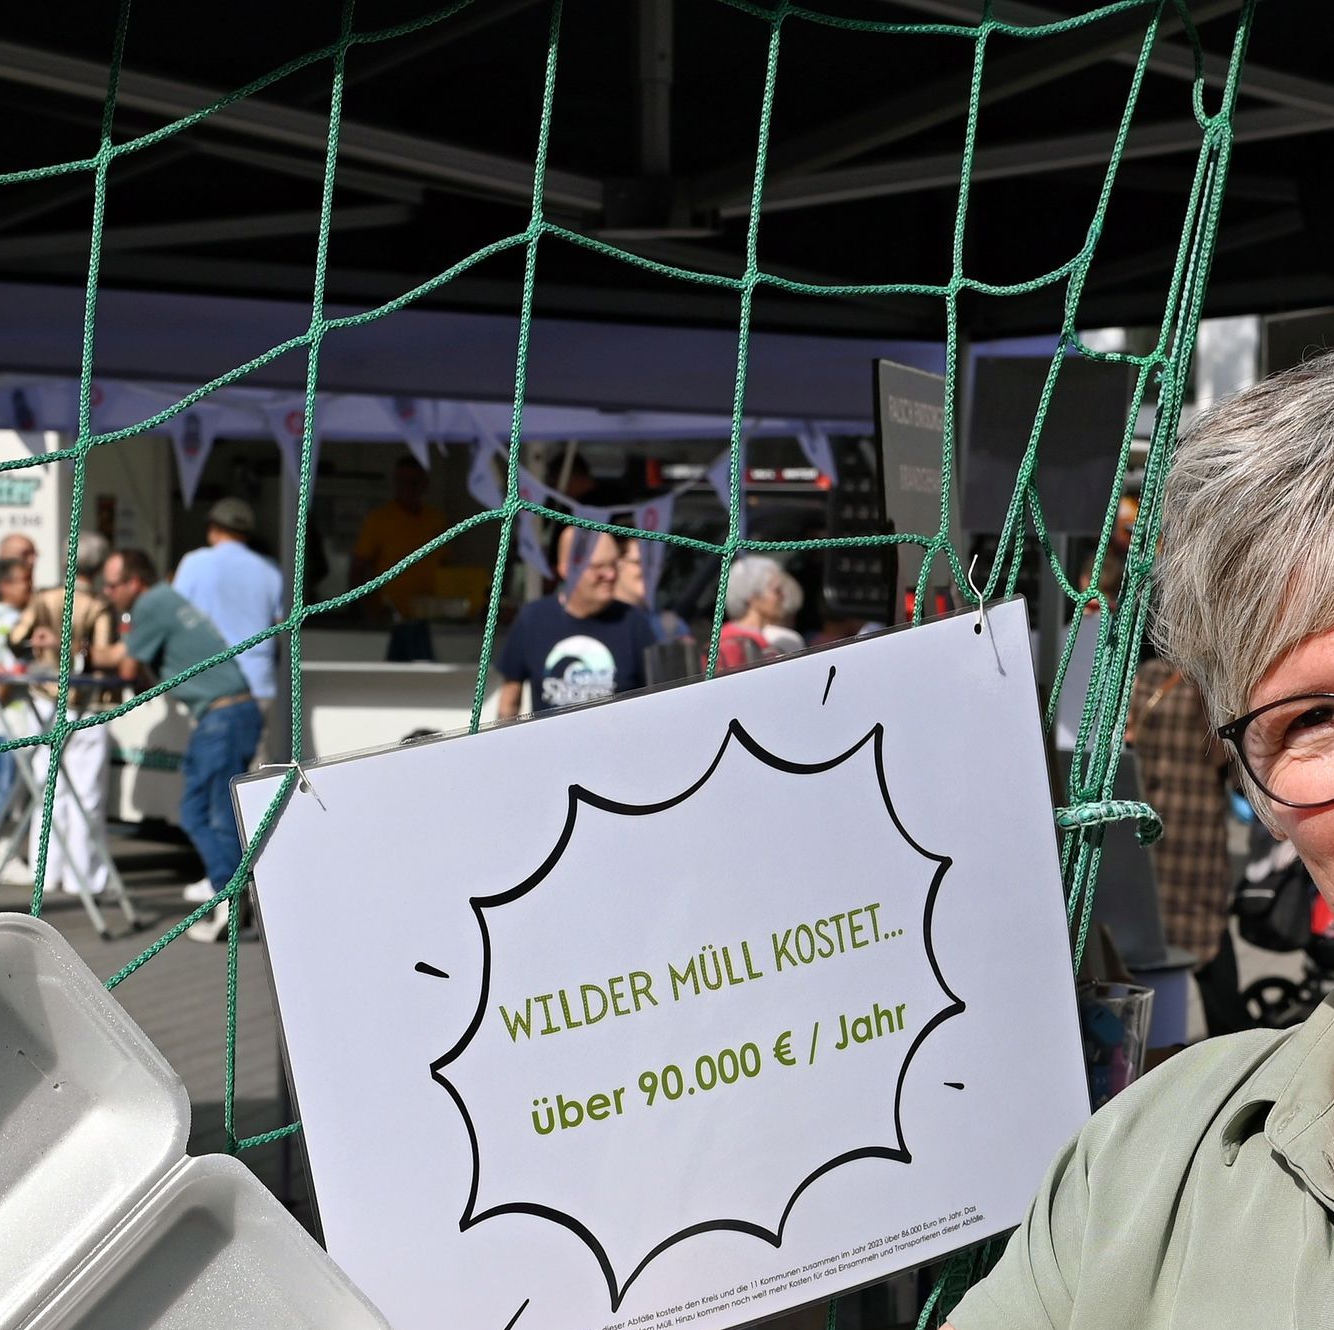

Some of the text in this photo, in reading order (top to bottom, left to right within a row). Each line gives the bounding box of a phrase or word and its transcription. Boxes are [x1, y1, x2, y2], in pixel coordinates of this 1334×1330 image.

[498, 902, 904, 1043] WILDER MÜLL KOSTET...
[531, 1002, 907, 1136] über 90.000 € / Jahr
[656, 1305, 683, 1318] kostete
[684, 1299, 701, 1310] den
[701, 1293, 719, 1304] Kreis
[719, 1288, 735, 1299] und
[736, 1284, 749, 1293] die
[750, 1280, 758, 1289] 11
[760, 1268, 801, 1286] Kommunen
[802, 1255, 840, 1272] zusammen
[841, 1251, 850, 1259] im
[851, 1246, 866, 1256] Jahr
[868, 1238, 884, 1250] 2023
[884, 1233, 900, 1244] über
[901, 1224, 922, 1238] 86.000
[922, 1220, 938, 1230] Euro
[938, 1216, 947, 1224] im
[964, 1205, 977, 1215] Das
[675, 1313, 696, 1324] Hinzu
[697, 1303, 730, 1318] kommen
[731, 1296, 750, 1307] noch
[752, 1290, 768, 1300] weit
[768, 1284, 788, 1295] mehr
[789, 1275, 812, 1289] Kosten
[813, 1272, 823, 1280] für
[824, 1267, 838, 1277] das
[838, 1252, 880, 1272] Einsammeln
[880, 1247, 894, 1257] und
[894, 1230, 941, 1252] Transportieren
[941, 1223, 961, 1235] dieser
